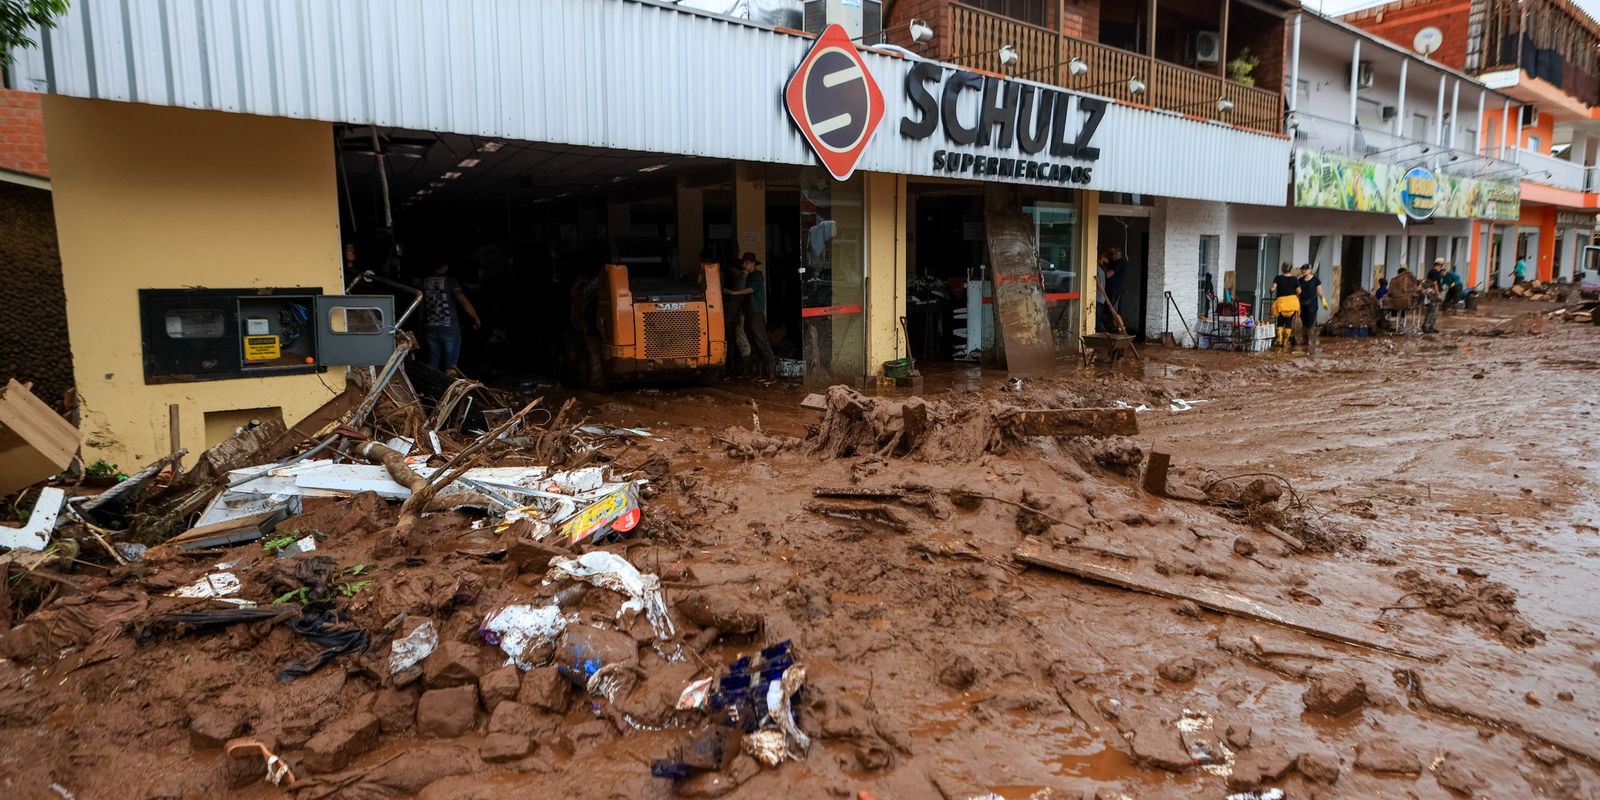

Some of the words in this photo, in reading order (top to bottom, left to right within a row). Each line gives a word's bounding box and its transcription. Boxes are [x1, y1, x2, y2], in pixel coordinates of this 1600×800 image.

[900, 62, 1106, 160] SCHULZ
[932, 150, 1092, 184] SUPERMERCADOS
[655, 303, 687, 311] CASE
